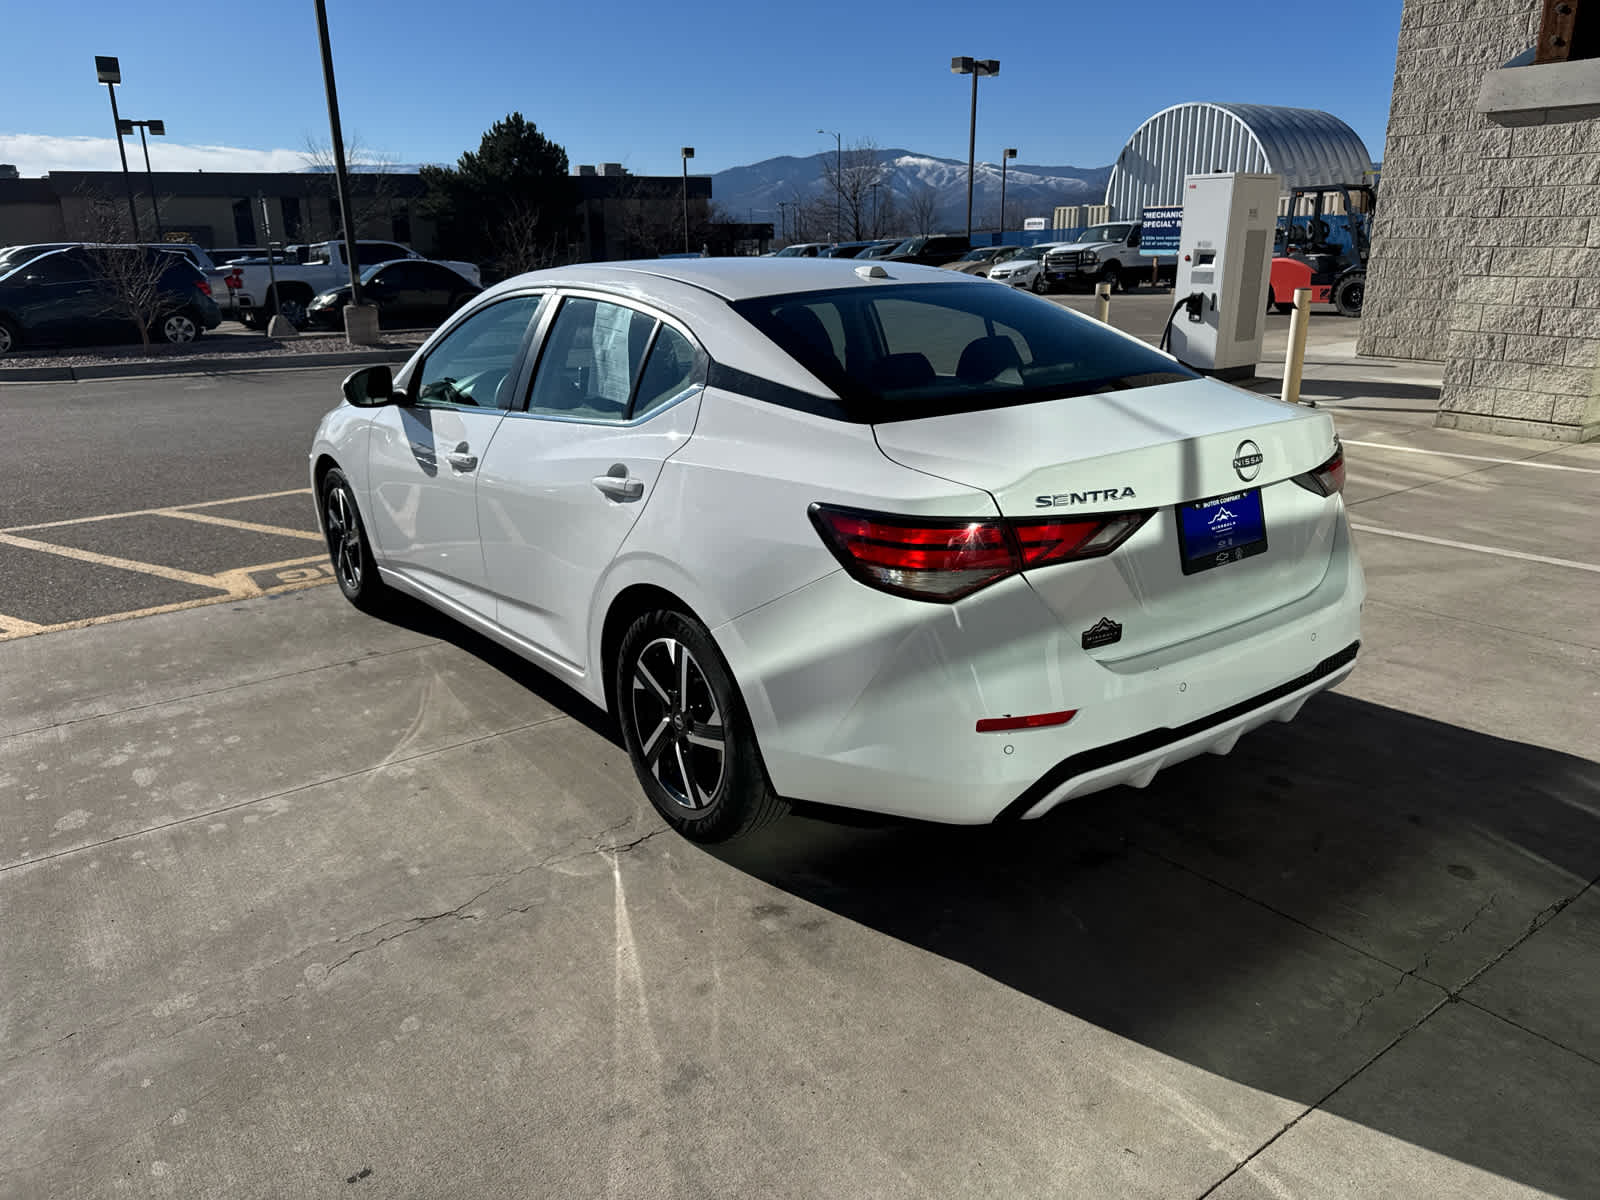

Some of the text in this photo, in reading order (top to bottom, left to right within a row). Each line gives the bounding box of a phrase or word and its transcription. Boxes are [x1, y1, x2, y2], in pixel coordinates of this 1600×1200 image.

[1234, 454, 1263, 468] NISSAN
[1035, 486, 1137, 509] SENTRA
[1219, 494, 1241, 505] COMPANY
